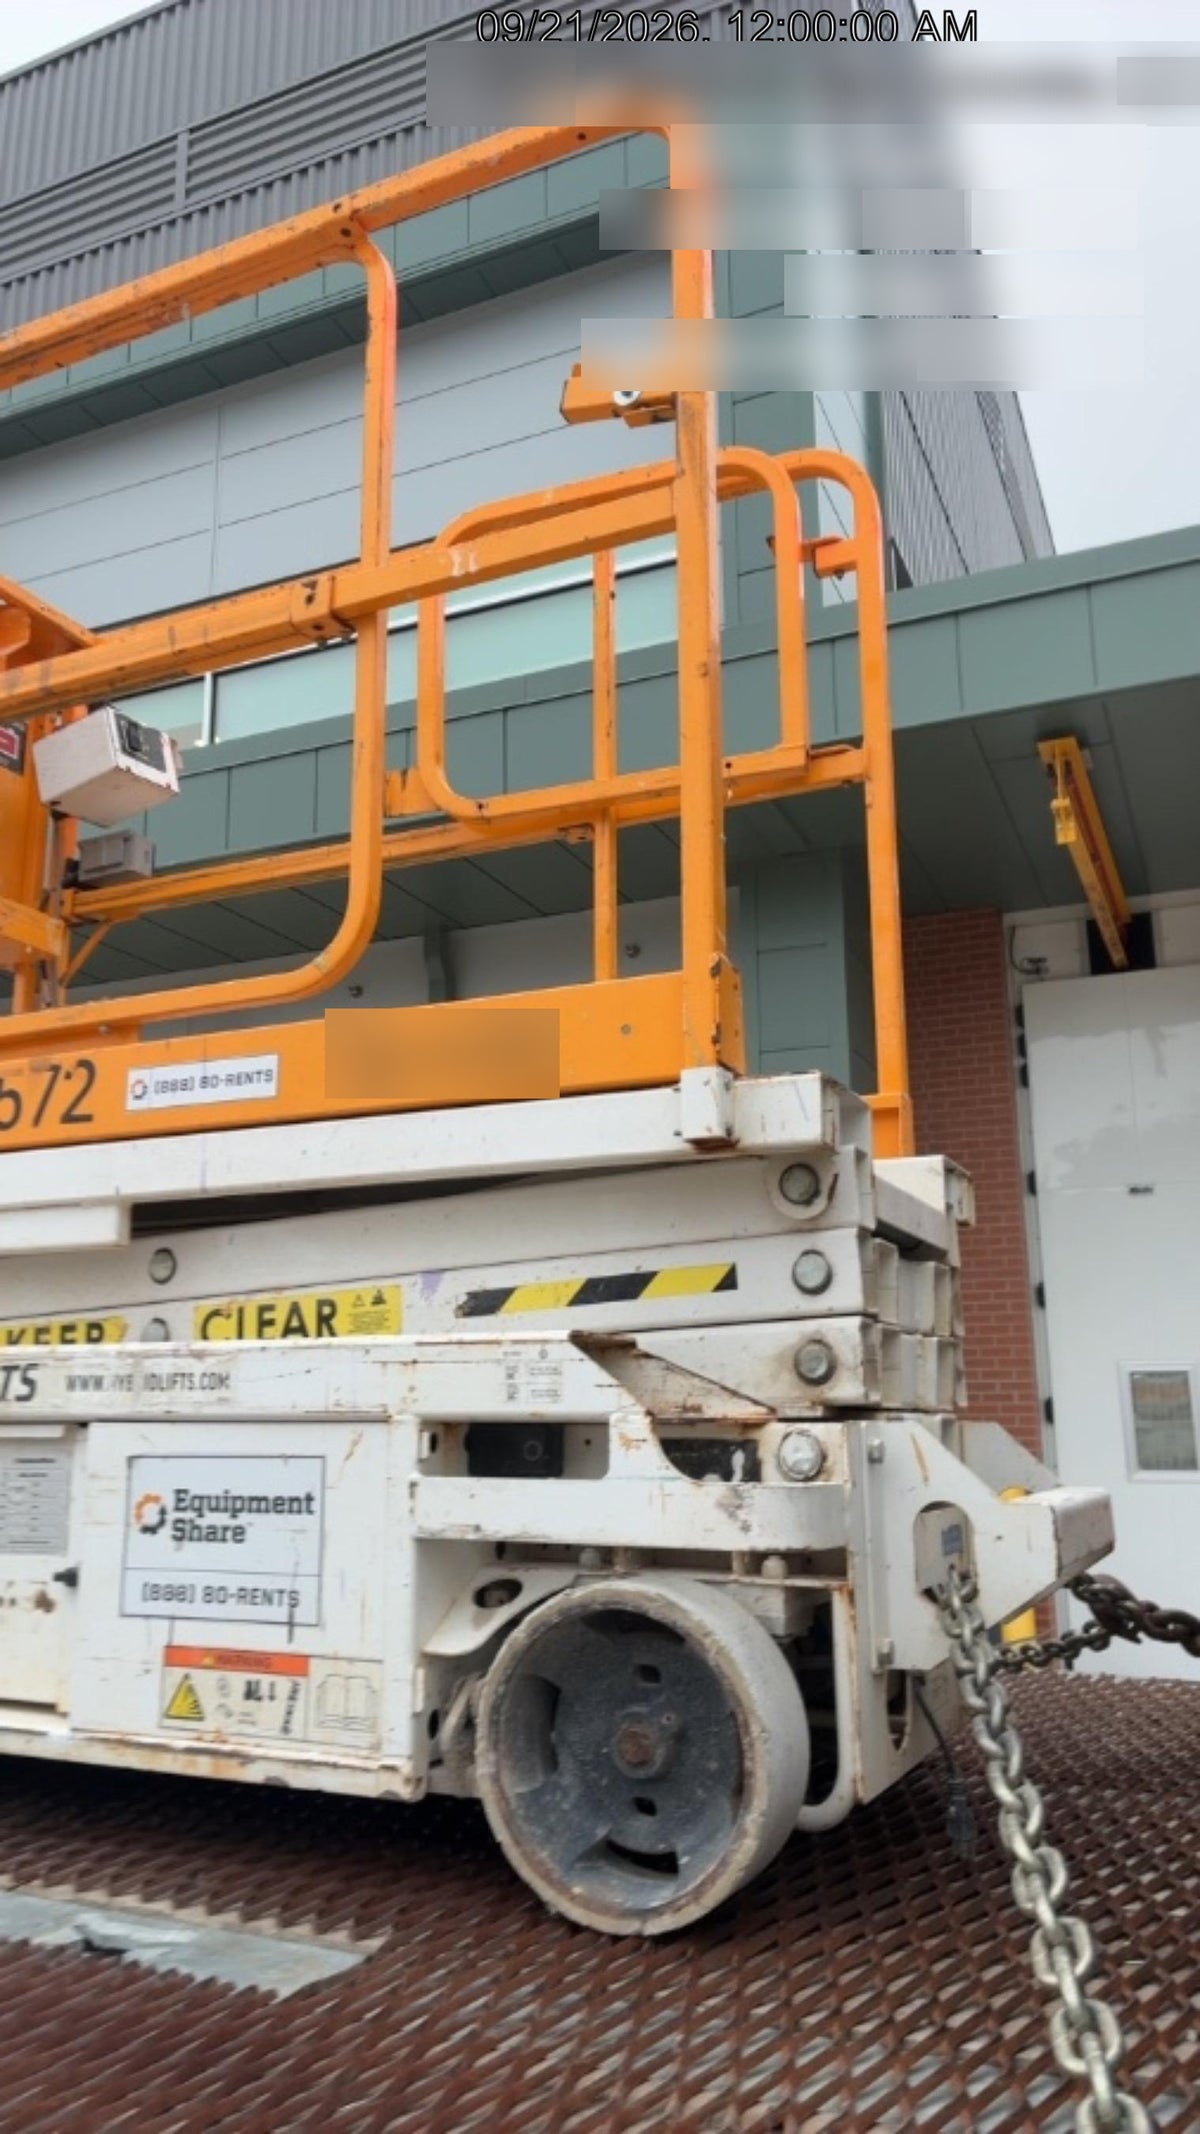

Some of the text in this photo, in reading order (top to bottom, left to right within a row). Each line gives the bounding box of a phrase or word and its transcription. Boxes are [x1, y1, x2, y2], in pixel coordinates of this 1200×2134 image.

[198, 1068, 274, 1090] 80-RENTS
[172, 1488, 315, 1519] Equipment
[170, 1517, 246, 1544] Share
[201, 1585, 301, 1609] 80-RENTS
